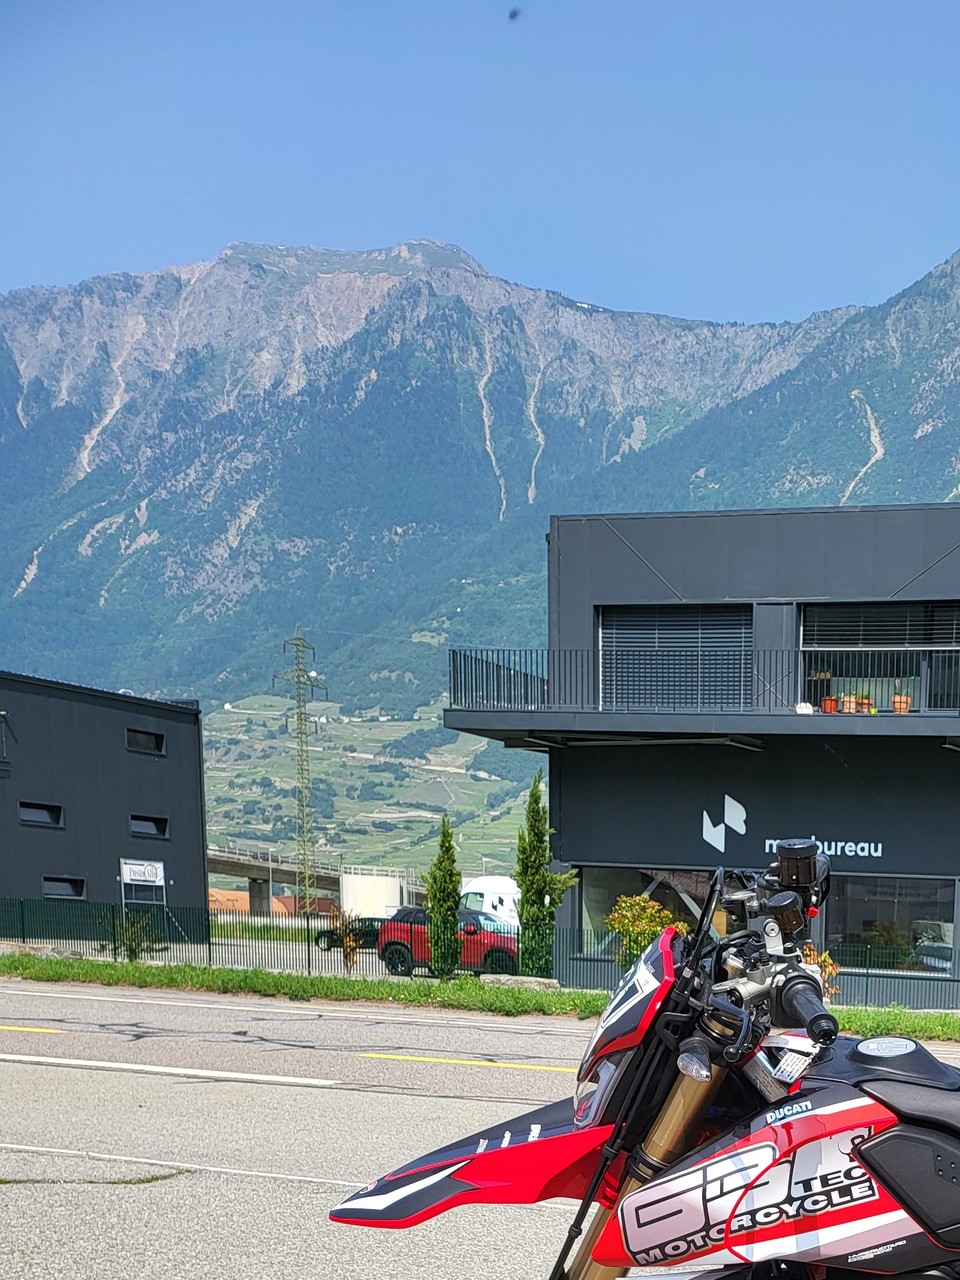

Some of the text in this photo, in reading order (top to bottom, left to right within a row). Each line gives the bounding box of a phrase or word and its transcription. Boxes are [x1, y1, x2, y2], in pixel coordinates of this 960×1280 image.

[764, 835, 883, 857] mbureau
[766, 1100, 813, 1124] DUCATI
[794, 1165, 868, 1194] TEC
[635, 1180, 875, 1265] MOTORCYCLE
